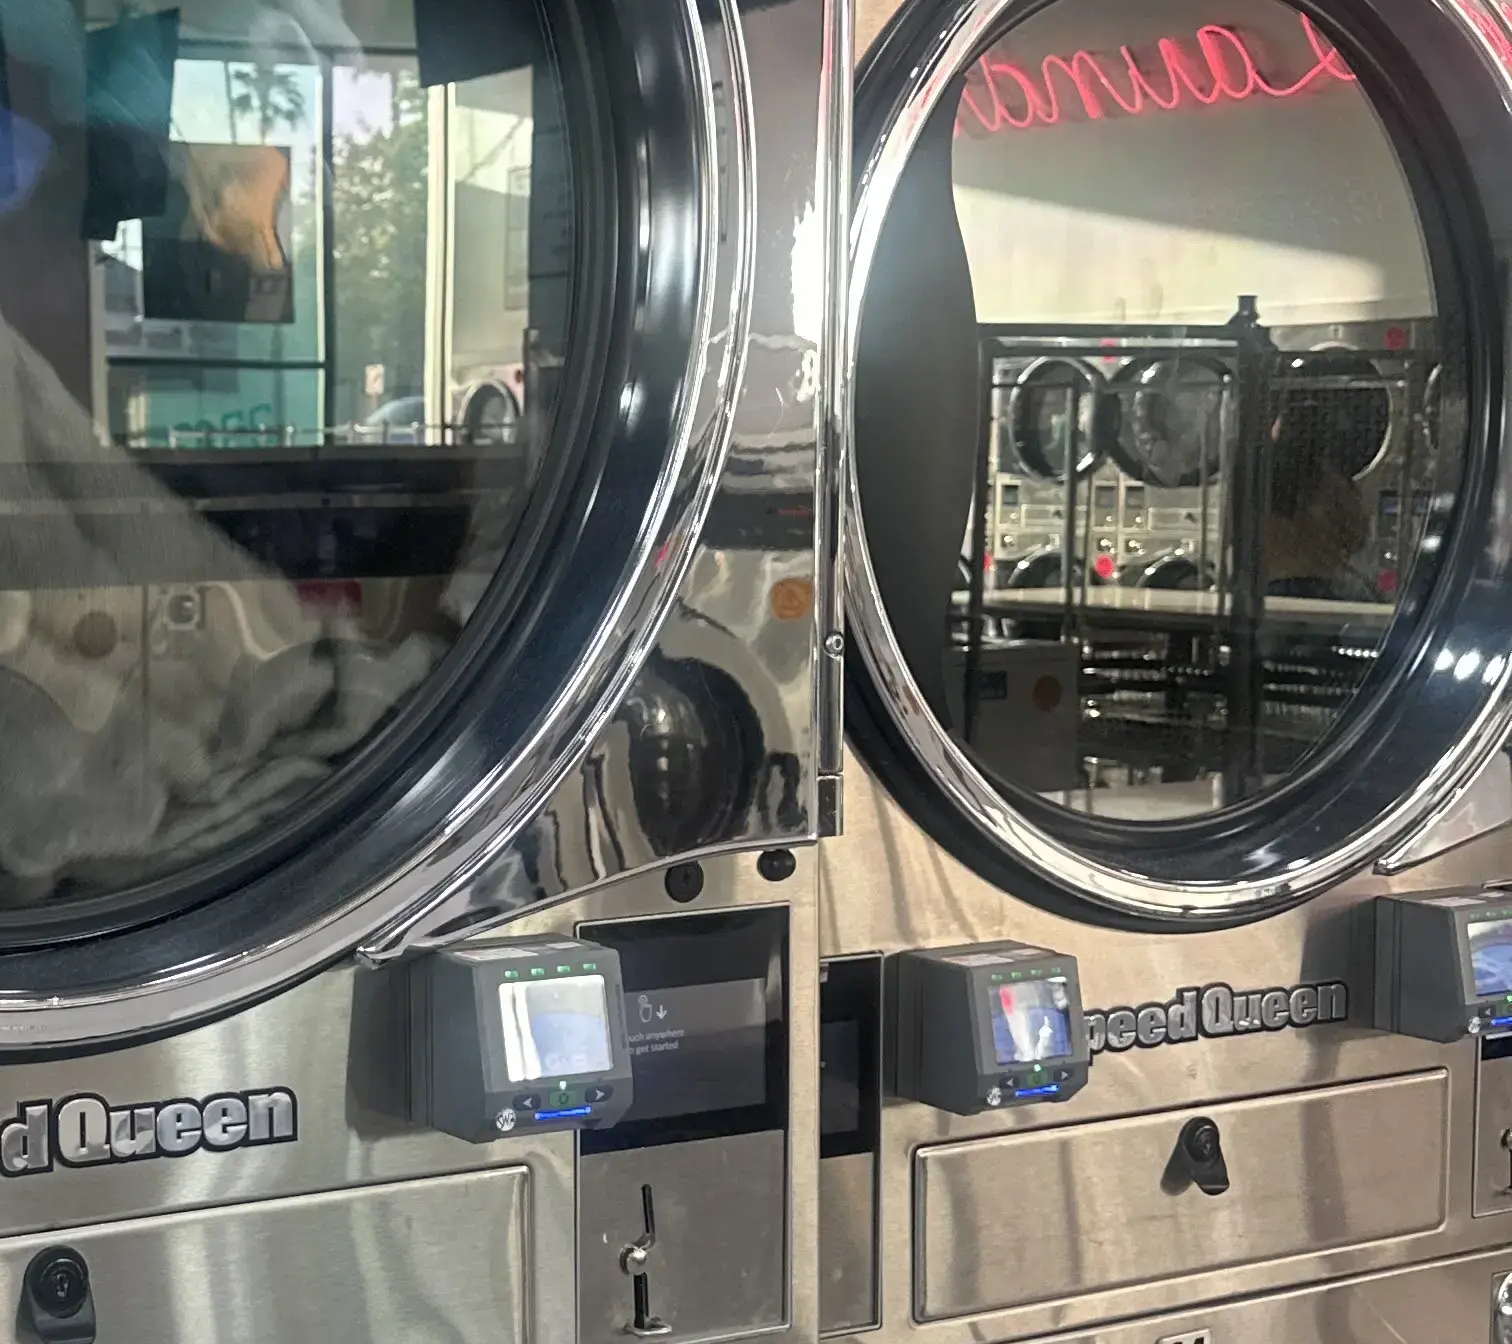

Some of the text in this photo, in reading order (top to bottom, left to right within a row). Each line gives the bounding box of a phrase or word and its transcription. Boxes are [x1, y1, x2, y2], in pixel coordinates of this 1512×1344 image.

[651, 1040, 679, 1053] started
[1083, 981, 1349, 1067] peed Queen
[54, 1086, 299, 1170] Queen
